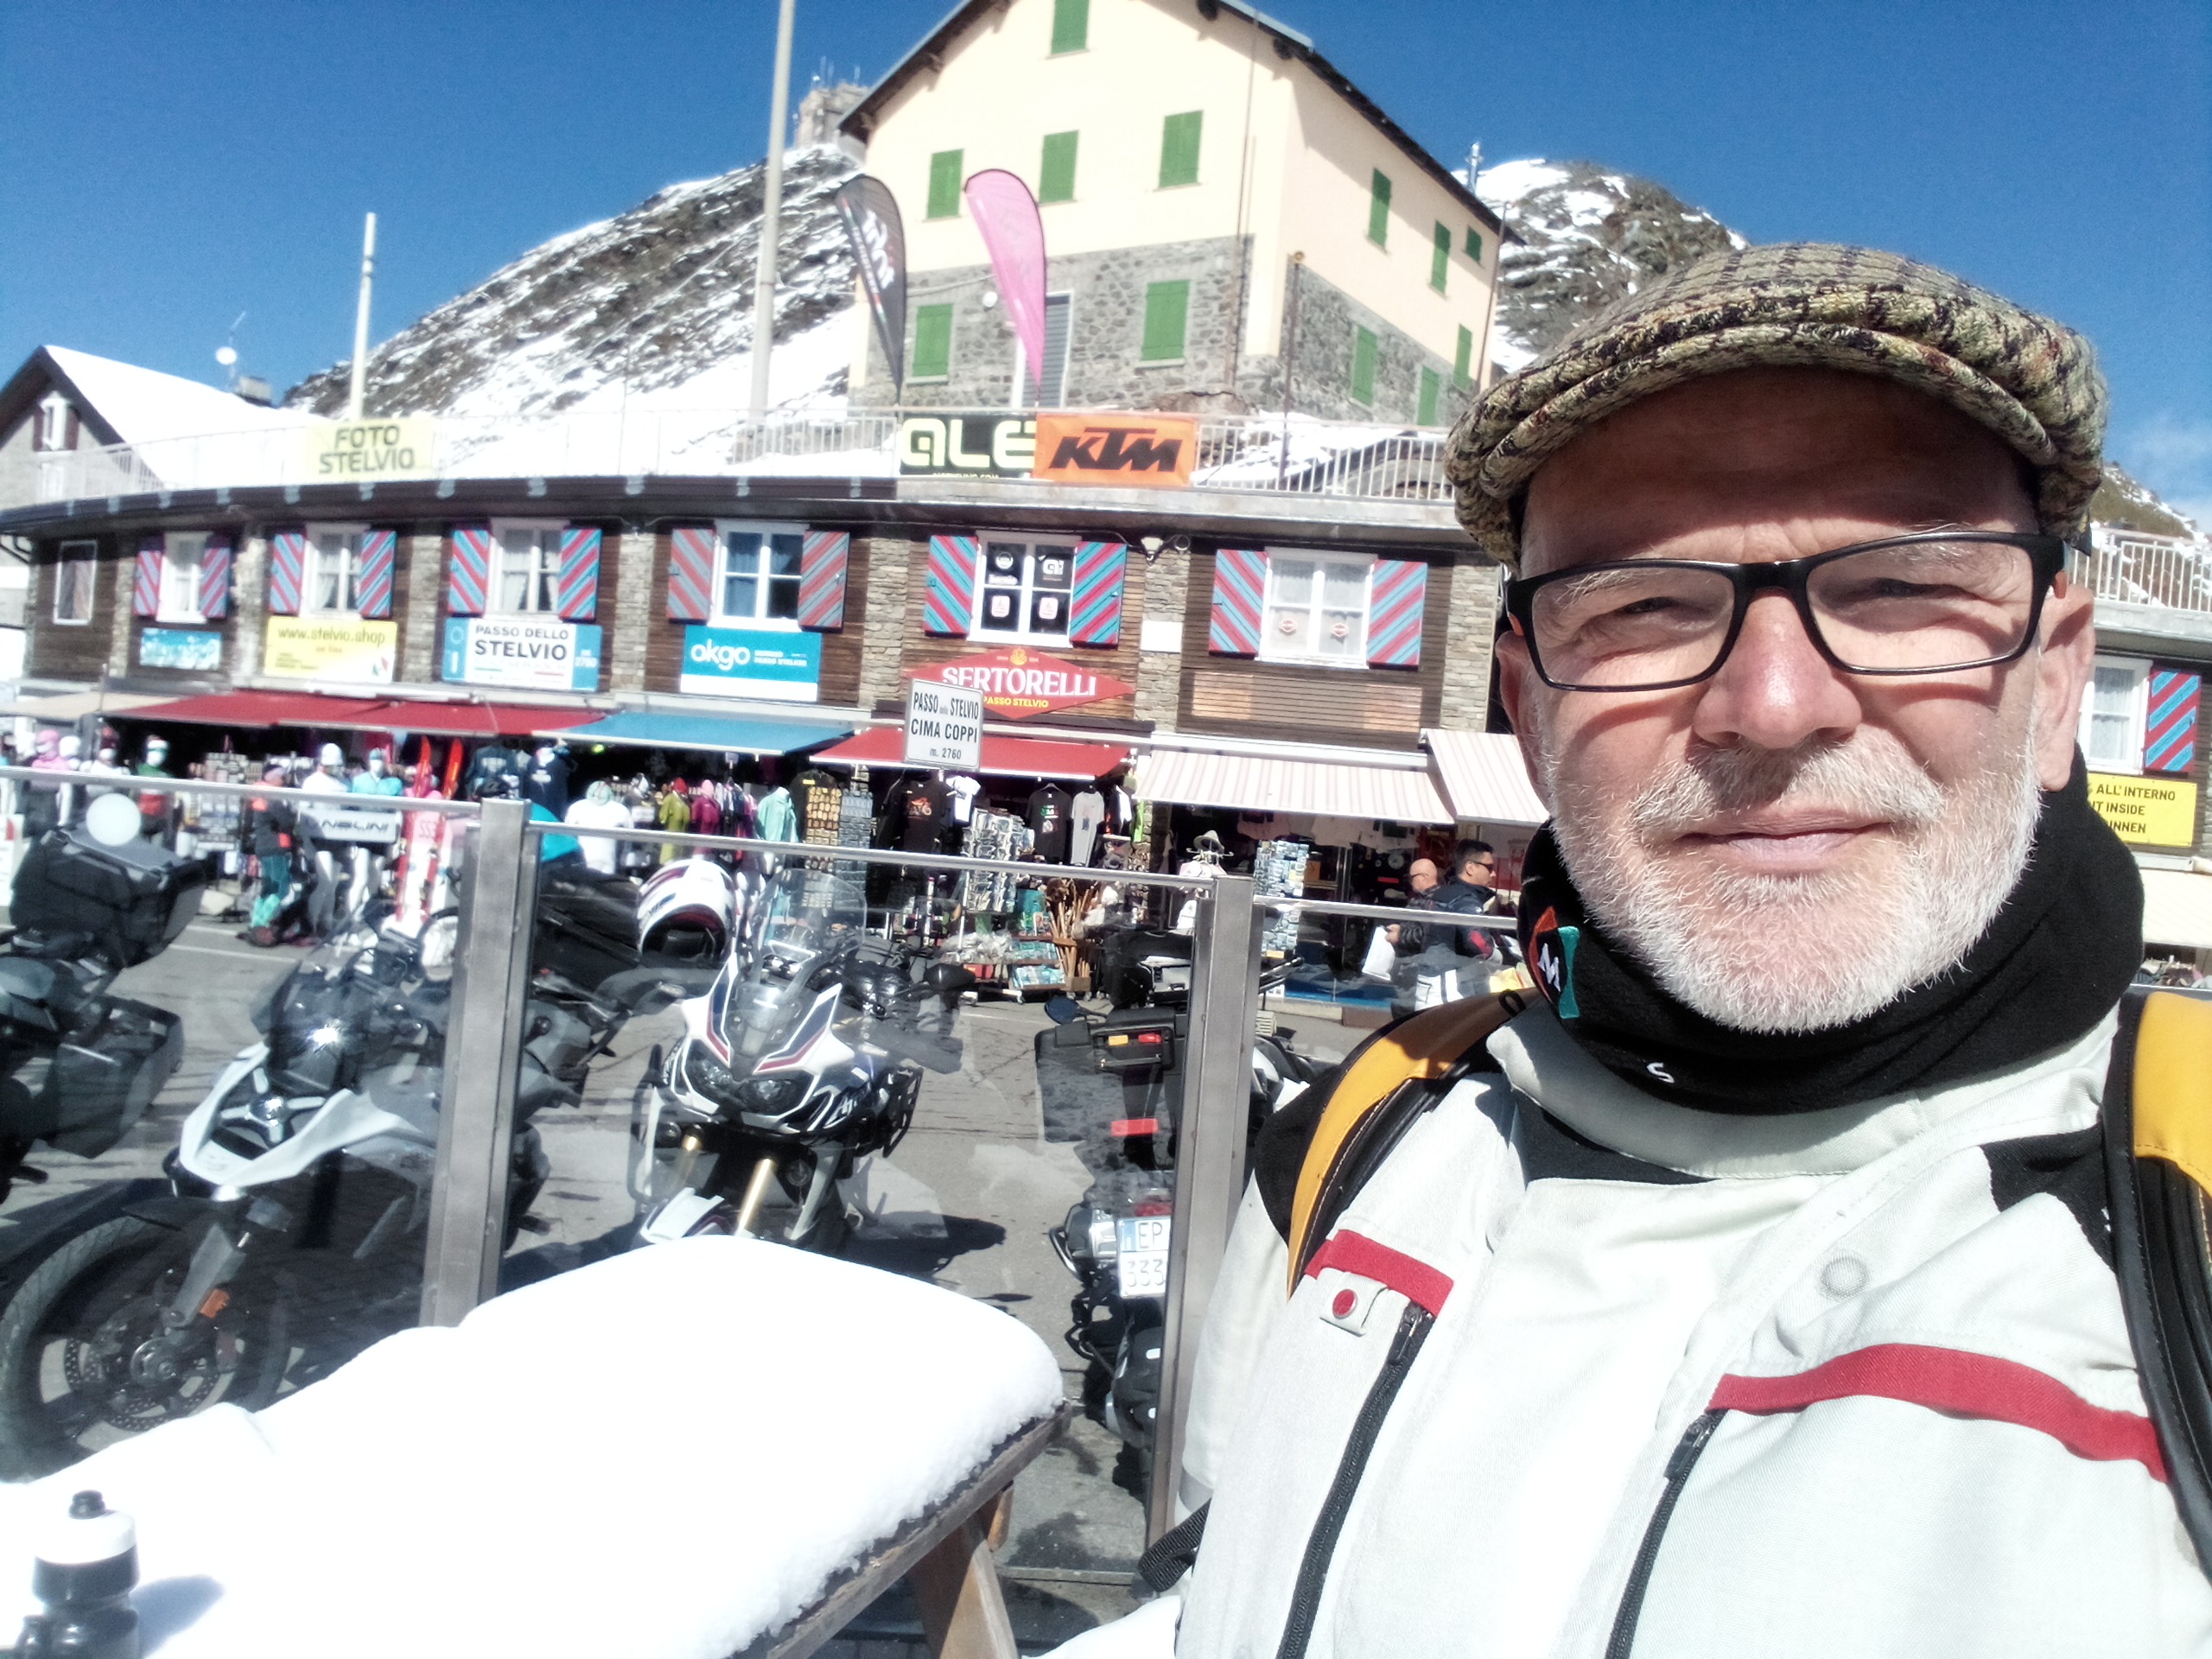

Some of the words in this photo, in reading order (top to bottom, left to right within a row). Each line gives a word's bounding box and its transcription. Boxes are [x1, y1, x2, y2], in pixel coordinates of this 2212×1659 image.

[334, 424, 401, 448] FOTO
[318, 448, 415, 474] STELVIO
[1048, 427, 1183, 473] KTM
[278, 626, 386, 648] www.stelvio.shop
[475, 624, 519, 637] PASSO
[524, 627, 569, 640] DELLO
[474, 639, 567, 661] STELVIO
[691, 638, 751, 671] okgo
[942, 666, 1096, 696] SERTORELLI
[912, 691, 939, 714] PASSO
[950, 697, 979, 720] STELVIO
[1013, 698, 1049, 709] STELVIO
[911, 718, 941, 738] CIMA
[944, 723, 978, 743] COPPI
[942, 747, 962, 760] 2760
[2106, 802, 2145, 816] INSIDE
[2108, 820, 2146, 834] INNEN
[1138, 1221, 1163, 1249] EP
[1127, 1258, 1166, 1287] 333
